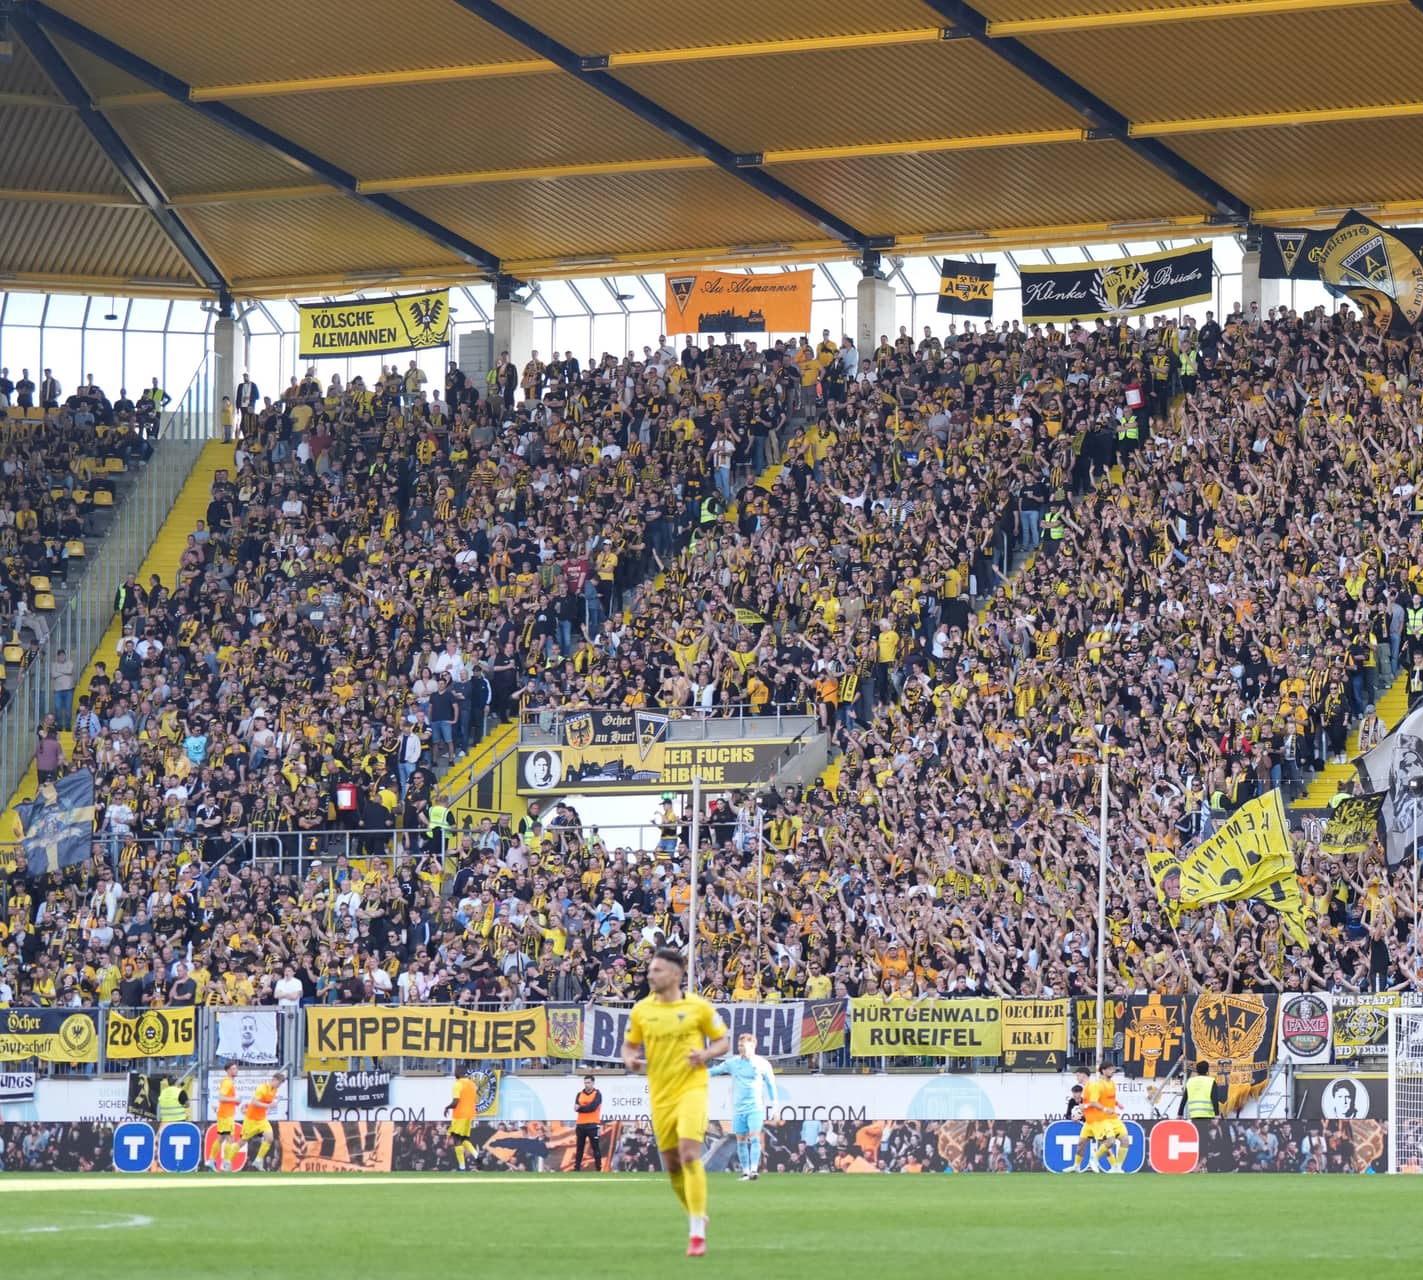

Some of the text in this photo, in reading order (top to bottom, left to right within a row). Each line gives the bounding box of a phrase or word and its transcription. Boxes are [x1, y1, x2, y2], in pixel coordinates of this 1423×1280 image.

[311, 310, 375, 329] KÖLSCHE
[312, 328, 397, 348] ALEMANNEN
[602, 712, 633, 727] Öcher
[696, 747, 754, 763] FUCHS
[1357, 995, 1395, 1005] STADT
[853, 1004, 999, 1022] HÜRTGENWALD
[1005, 1003, 1064, 1019] OECHER
[8, 1010, 41, 1032] Öcher
[1287, 1019, 1326, 1032] FAXE
[172, 1018, 194, 1043] 15
[317, 1009, 536, 1053] KAPPEHÄUER
[870, 1028, 982, 1046] RUREIFEL
[1011, 1031, 1054, 1045] KRAU
[612, 1098, 642, 1106] SICHER
